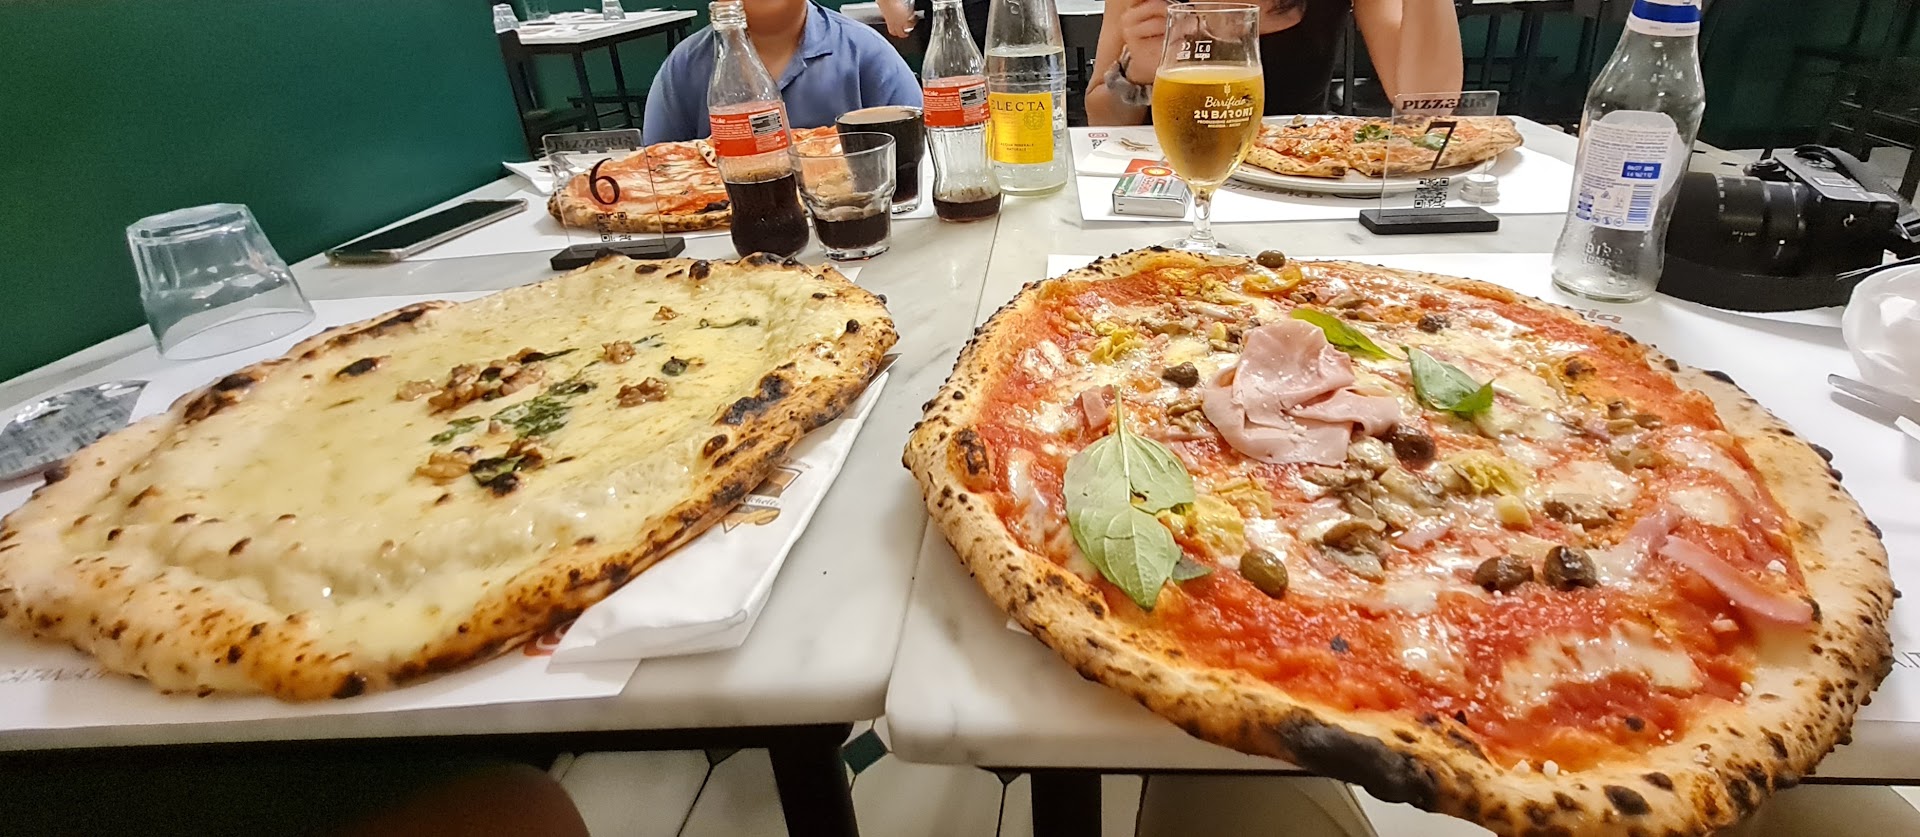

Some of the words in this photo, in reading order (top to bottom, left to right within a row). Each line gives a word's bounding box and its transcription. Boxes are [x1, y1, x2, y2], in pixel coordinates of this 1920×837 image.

[1204, 95, 1247, 109] Birrificio
[1402, 97, 1489, 110] PIZZERIA
[1193, 109, 1209, 120] 24
[1210, 106, 1254, 119] BARONI
[552, 136, 636, 150] PIZZERIA
[1424, 121, 1458, 169] 7
[589, 157, 621, 205] 6
